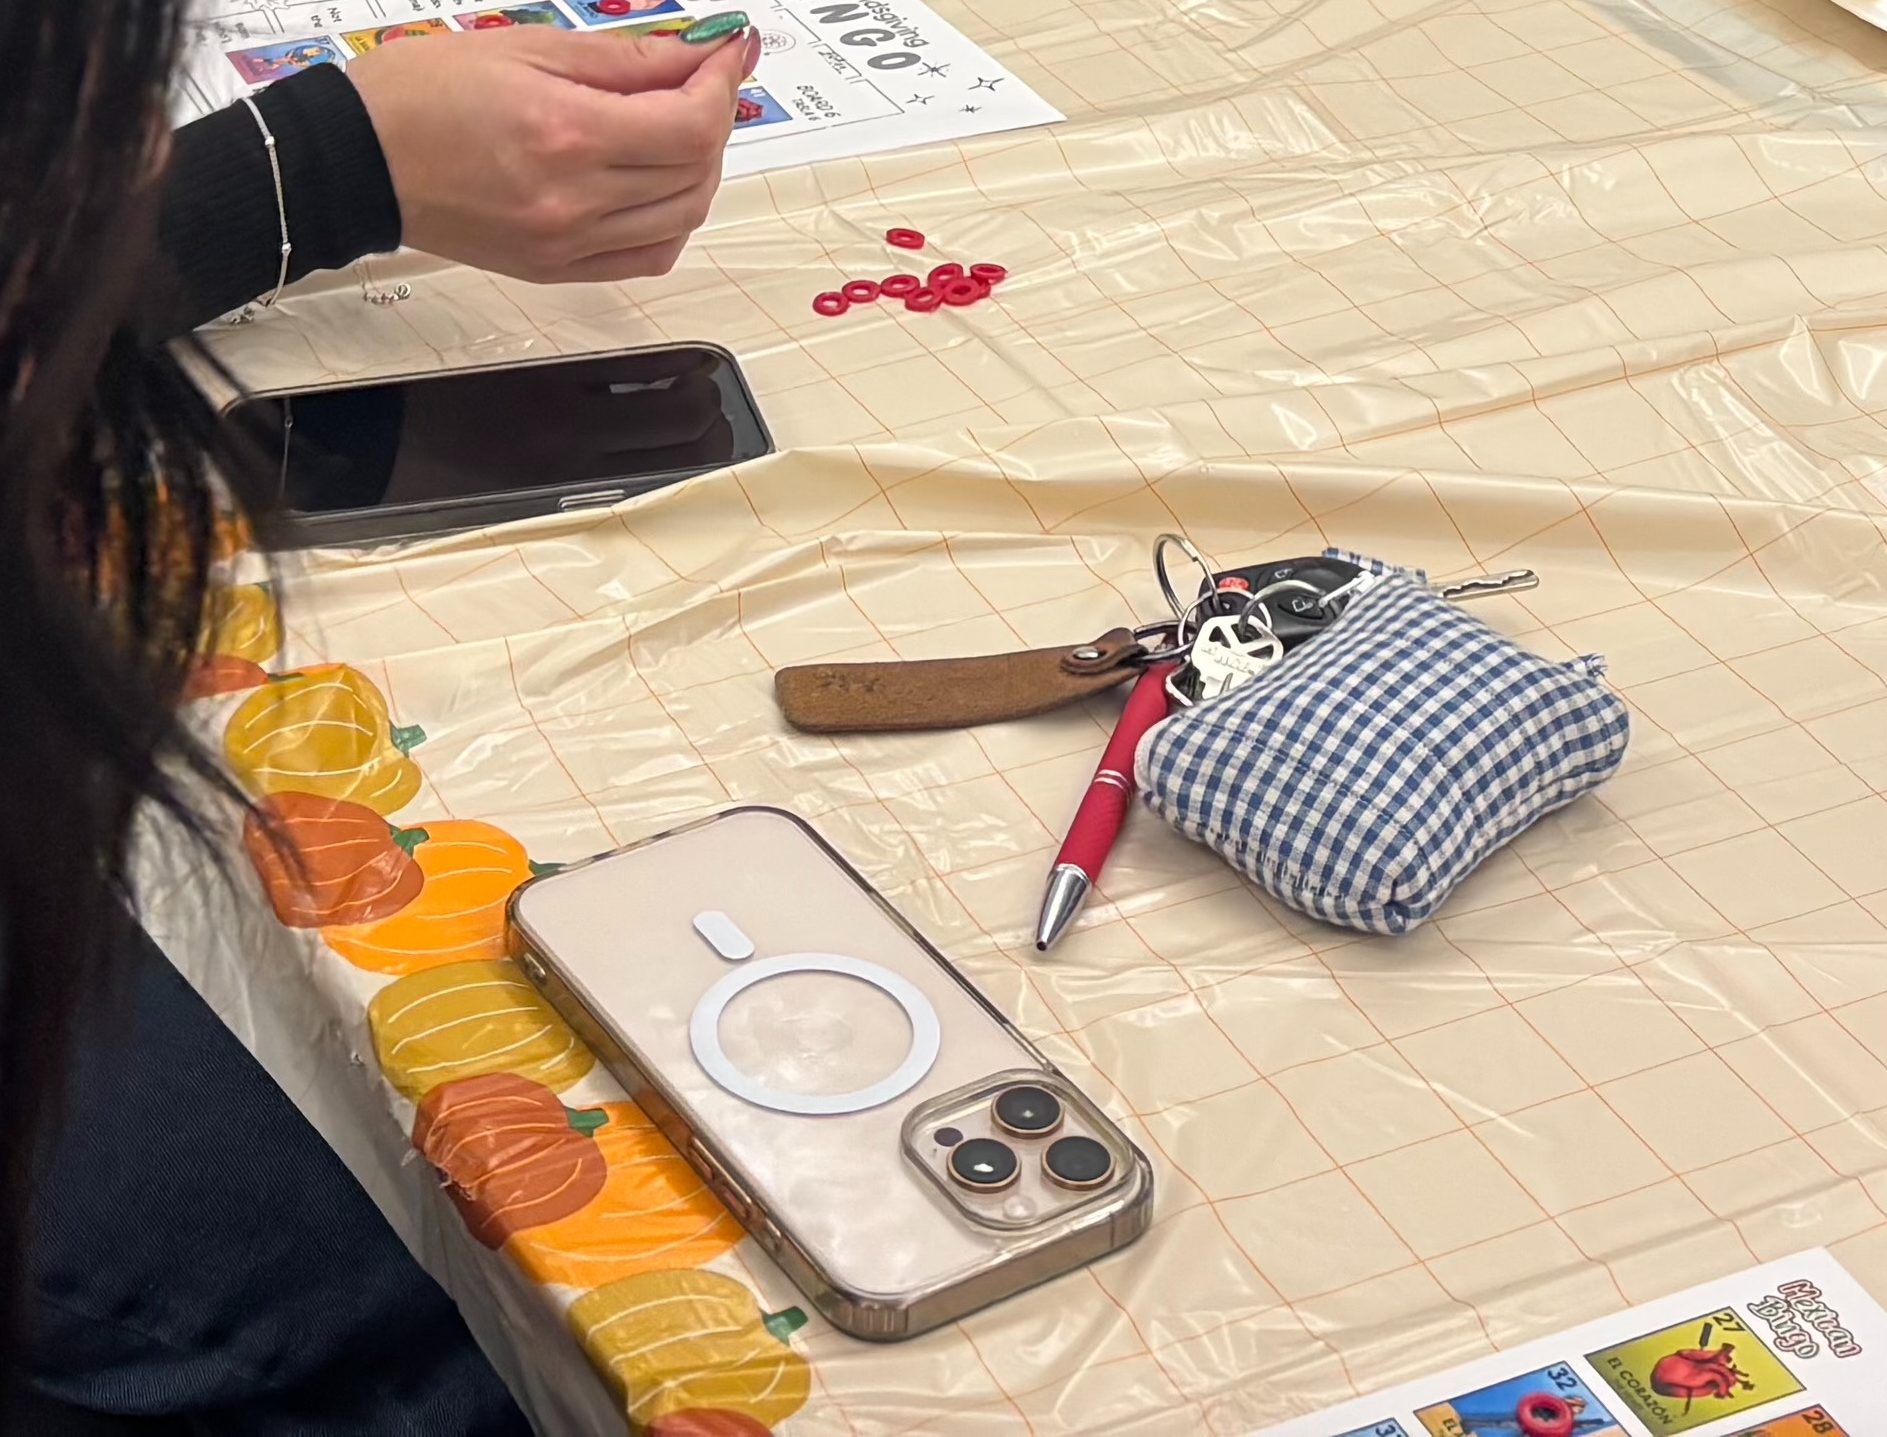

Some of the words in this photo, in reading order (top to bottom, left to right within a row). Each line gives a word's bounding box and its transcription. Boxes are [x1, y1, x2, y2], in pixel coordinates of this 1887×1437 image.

[1713, 1312, 1747, 1333] 27
[1747, 1294, 1820, 1360] Bingo
[1777, 1278, 1863, 1359] Mexican
[1547, 1367, 1578, 1392] 32
[1607, 1356, 1623, 1370] EL
[1619, 1369, 1673, 1425] CORAZÓN
[1375, 1423, 1403, 1437] 3
[1801, 1409, 1834, 1435] 28
